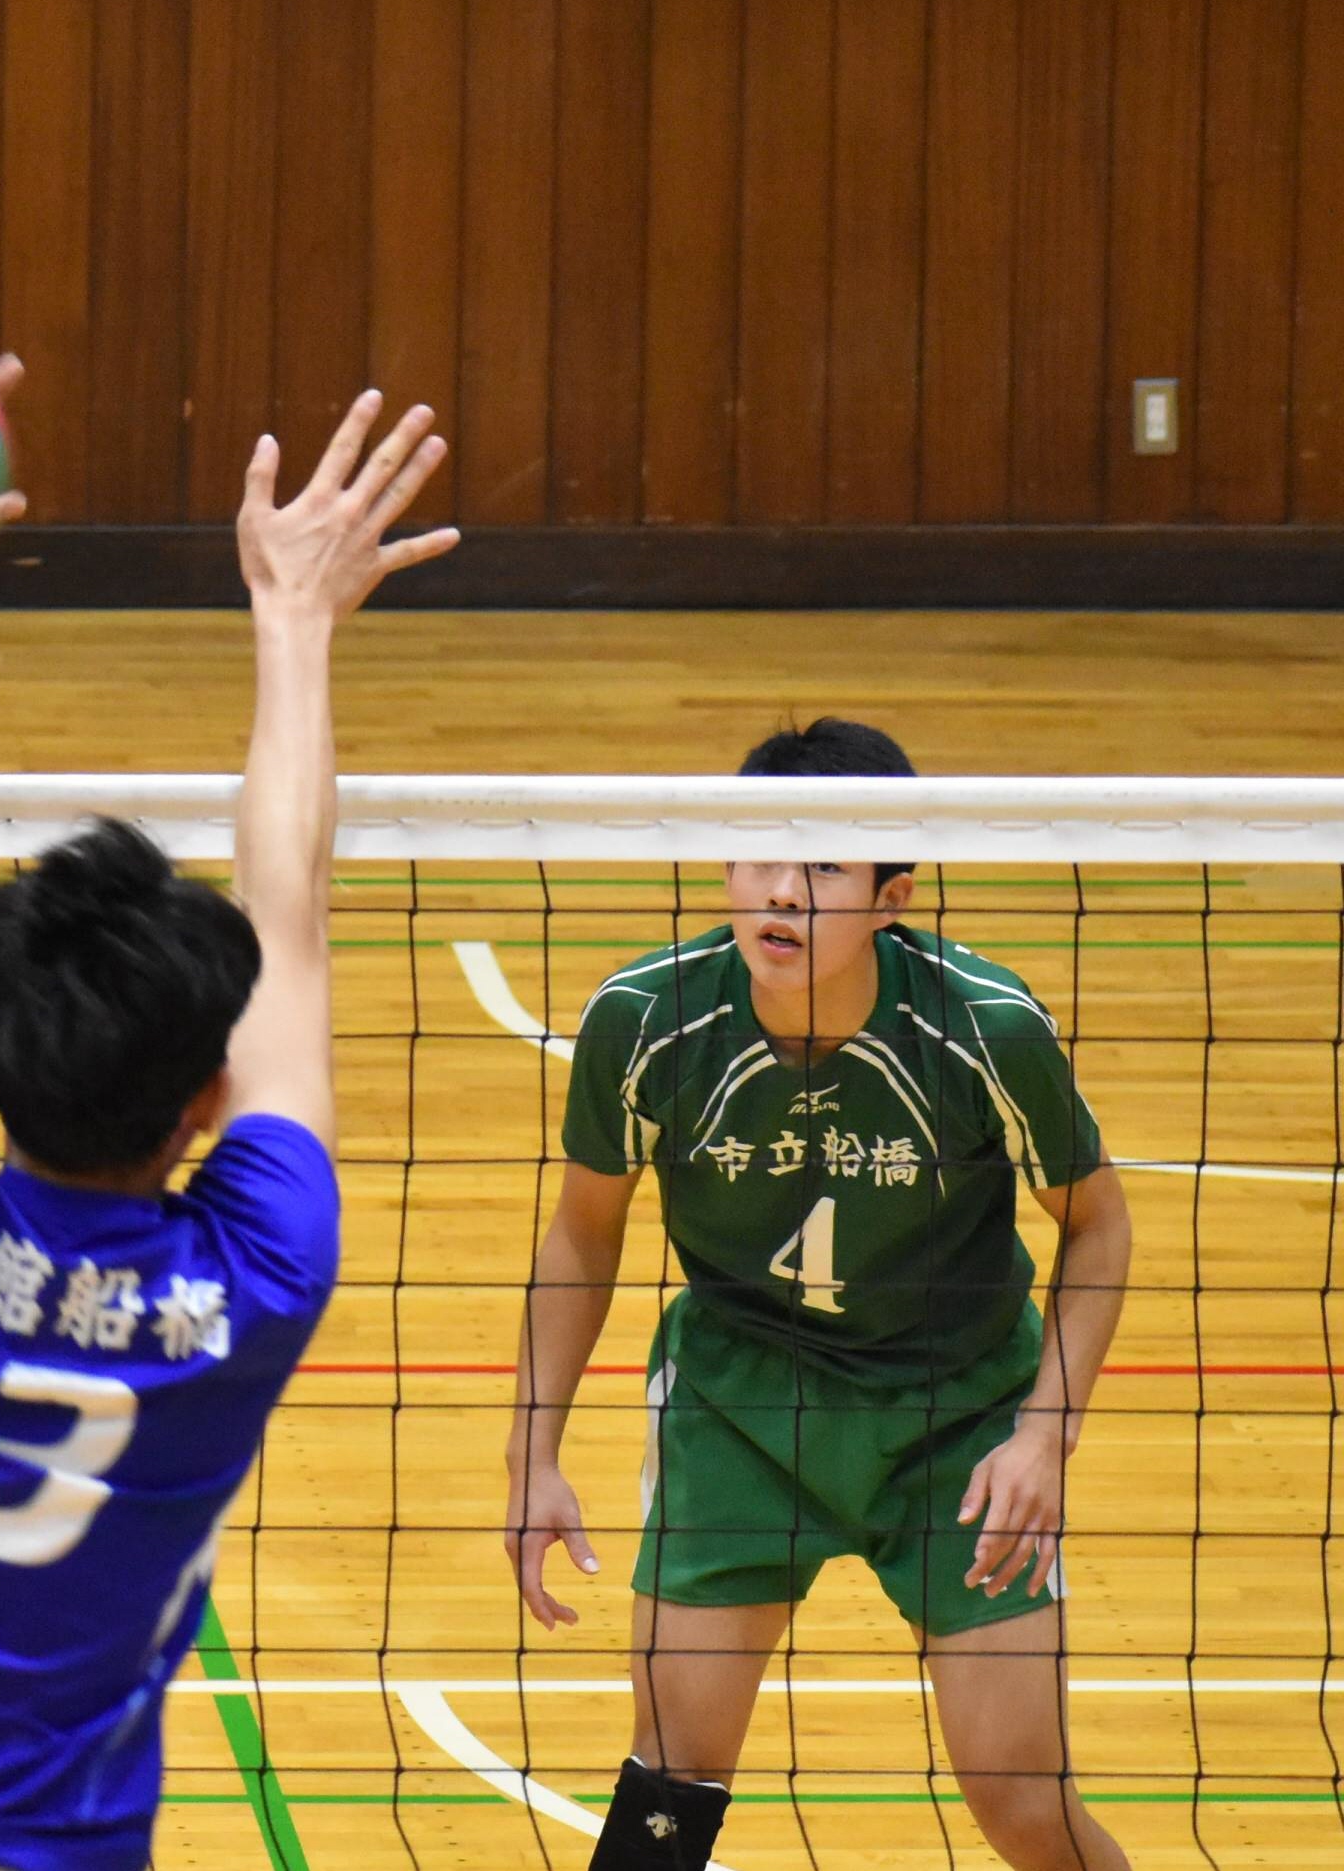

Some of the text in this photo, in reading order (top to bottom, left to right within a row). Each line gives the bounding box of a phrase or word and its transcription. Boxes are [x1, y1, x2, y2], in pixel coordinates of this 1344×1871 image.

[705, 1125, 921, 1188] 市立船橋
[769, 1196, 846, 1314] 4
